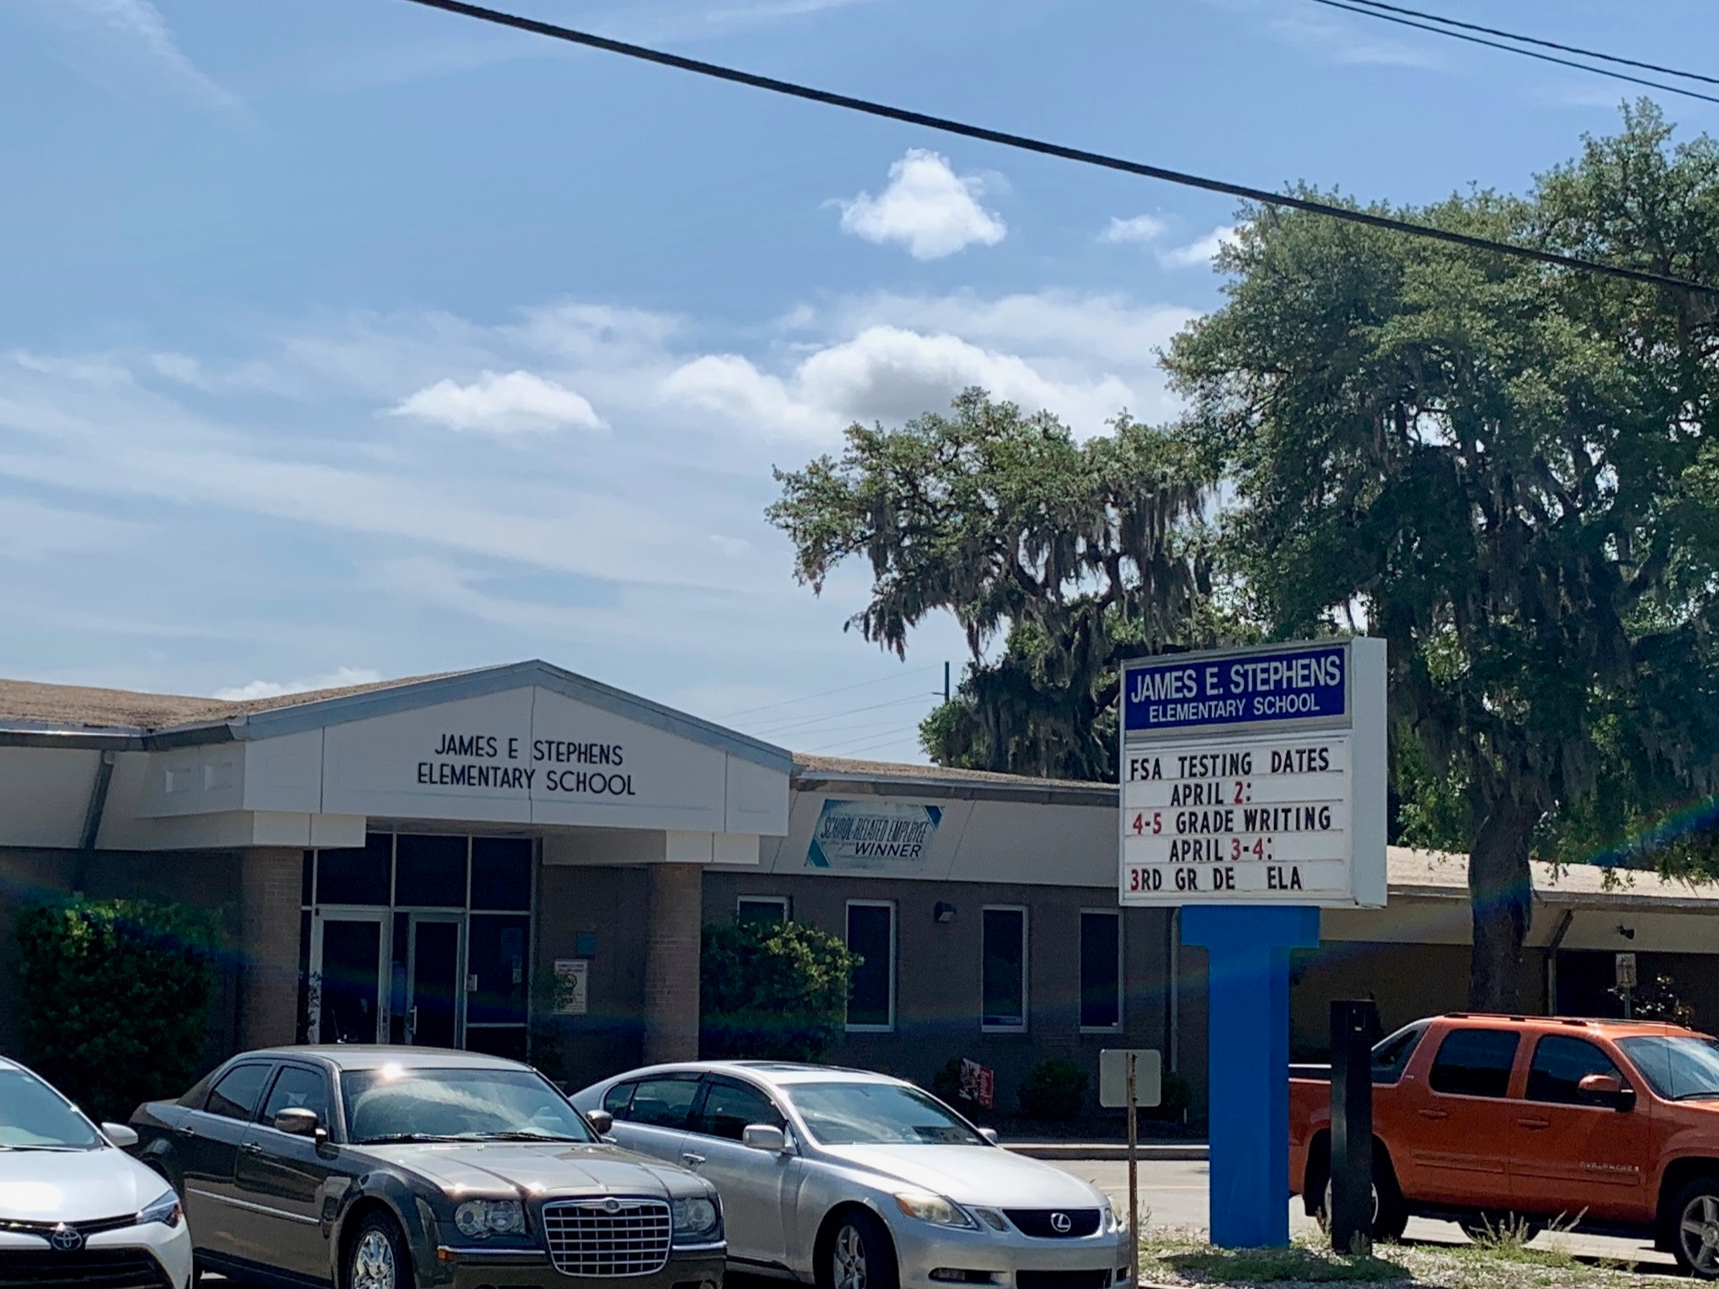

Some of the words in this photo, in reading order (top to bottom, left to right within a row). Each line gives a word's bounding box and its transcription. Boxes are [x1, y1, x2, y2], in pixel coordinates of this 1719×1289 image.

[1131, 669, 1197, 703] JAMES
[1206, 667, 1223, 696] E.
[1230, 655, 1341, 694] STEPHENS
[1149, 699, 1246, 723] ELEMENTARY
[1253, 693, 1320, 715] SCHOOL
[434, 734, 498, 758] JAMES
[508, 738, 518, 759] E
[533, 740, 623, 766] STEPHENS
[1130, 757, 1162, 781] FSA
[1178, 752, 1252, 778] TESTING
[1271, 747, 1330, 773] DATES
[417, 762, 536, 789] ELEMENTARY
[546, 770, 636, 796] SCHOOL
[1170, 783, 1224, 807] APRIL
[1234, 781, 1252, 804] 2:
[1132, 812, 1162, 835] 4-5
[1175, 810, 1234, 834] GRADE
[1243, 806, 1331, 832] WRITING
[855, 841, 922, 858] WINNER
[1169, 839, 1224, 862] APRIL
[1231, 837, 1273, 861] 3-4:
[1130, 868, 1162, 891] 3RD
[1267, 866, 1303, 890] ELA
